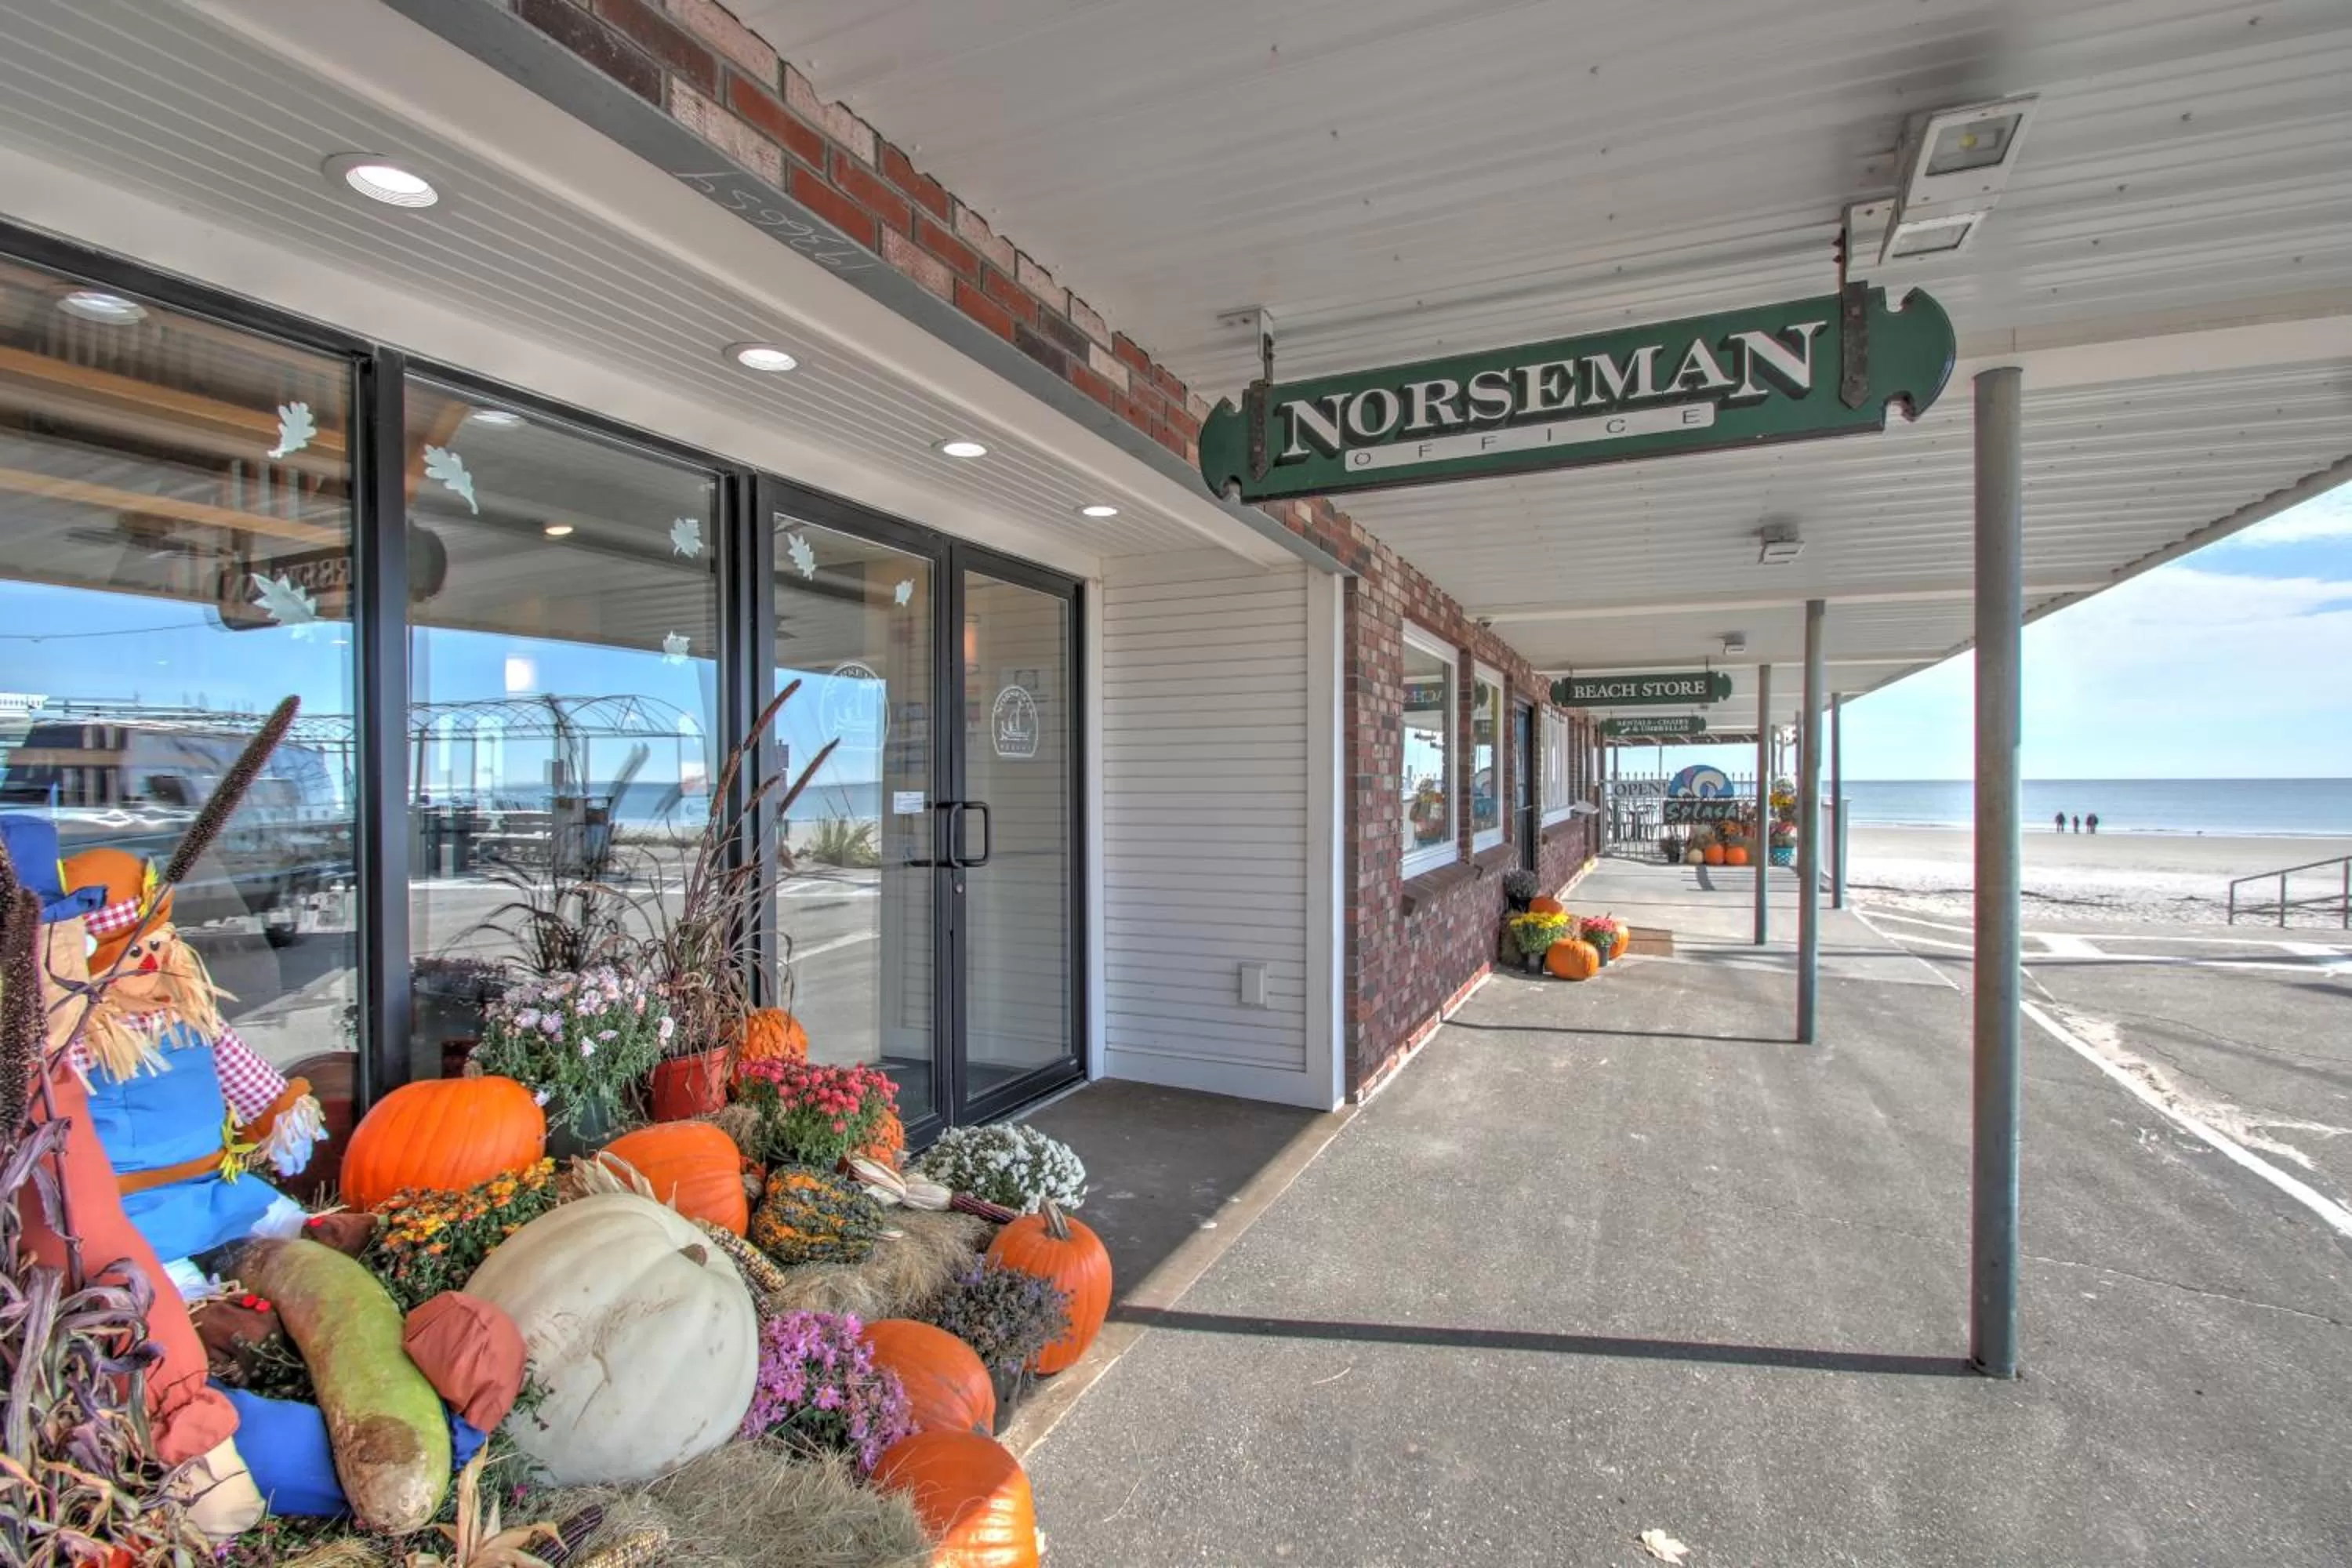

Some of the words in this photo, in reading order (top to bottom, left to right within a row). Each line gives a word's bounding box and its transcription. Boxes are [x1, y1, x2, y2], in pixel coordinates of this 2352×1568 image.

[1281, 321, 1828, 459] NORSEMAN
[1353, 408, 1700, 466] OFFICE
[1573, 683, 1637, 699] BEACH
[1642, 681, 1707, 696] STORE
[1614, 782, 1661, 796] OPEN
